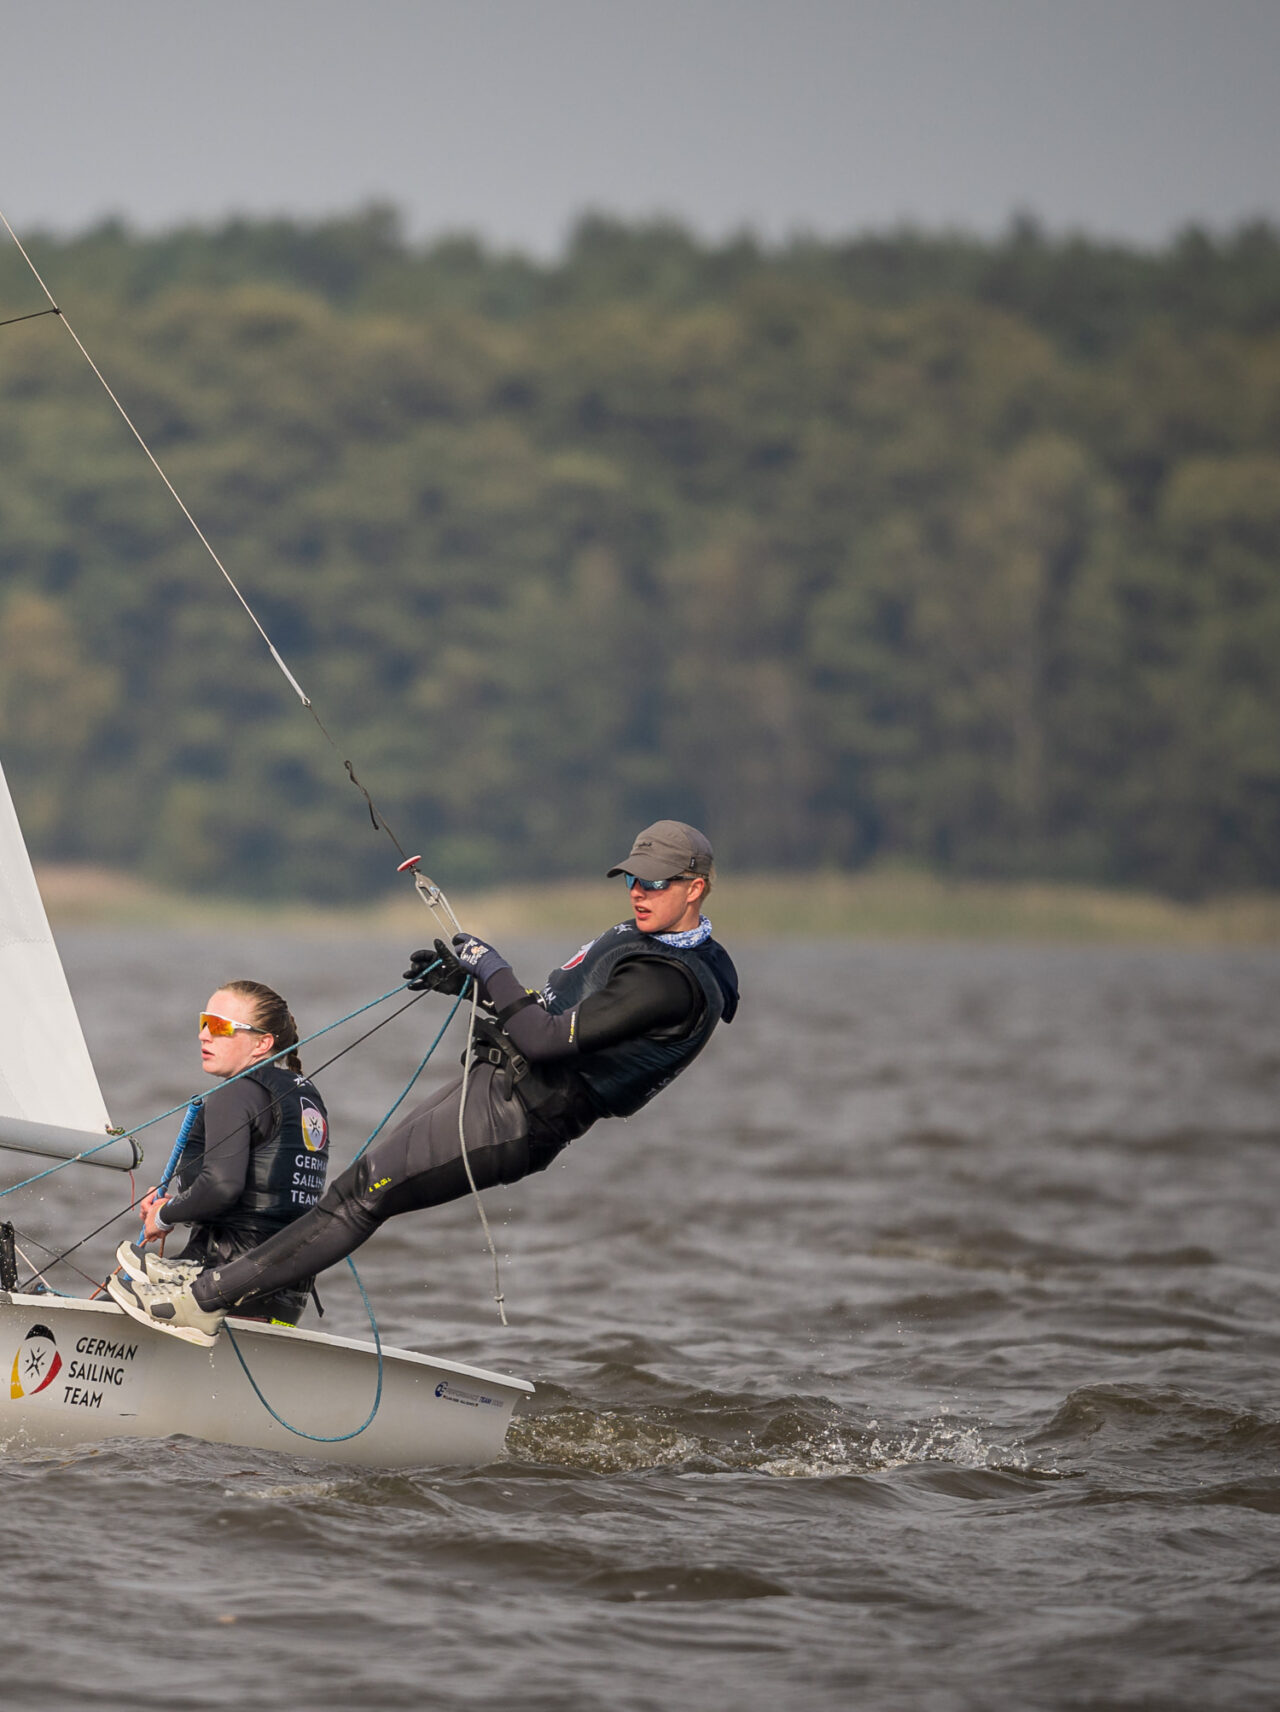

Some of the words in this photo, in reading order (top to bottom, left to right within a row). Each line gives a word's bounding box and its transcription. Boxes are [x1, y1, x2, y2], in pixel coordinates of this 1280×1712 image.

[291, 1189, 318, 1206] TEAM
[76, 1337, 138, 1360] GERMAN
[68, 1361, 124, 1386] SAILING
[63, 1386, 103, 1408] TEAM
